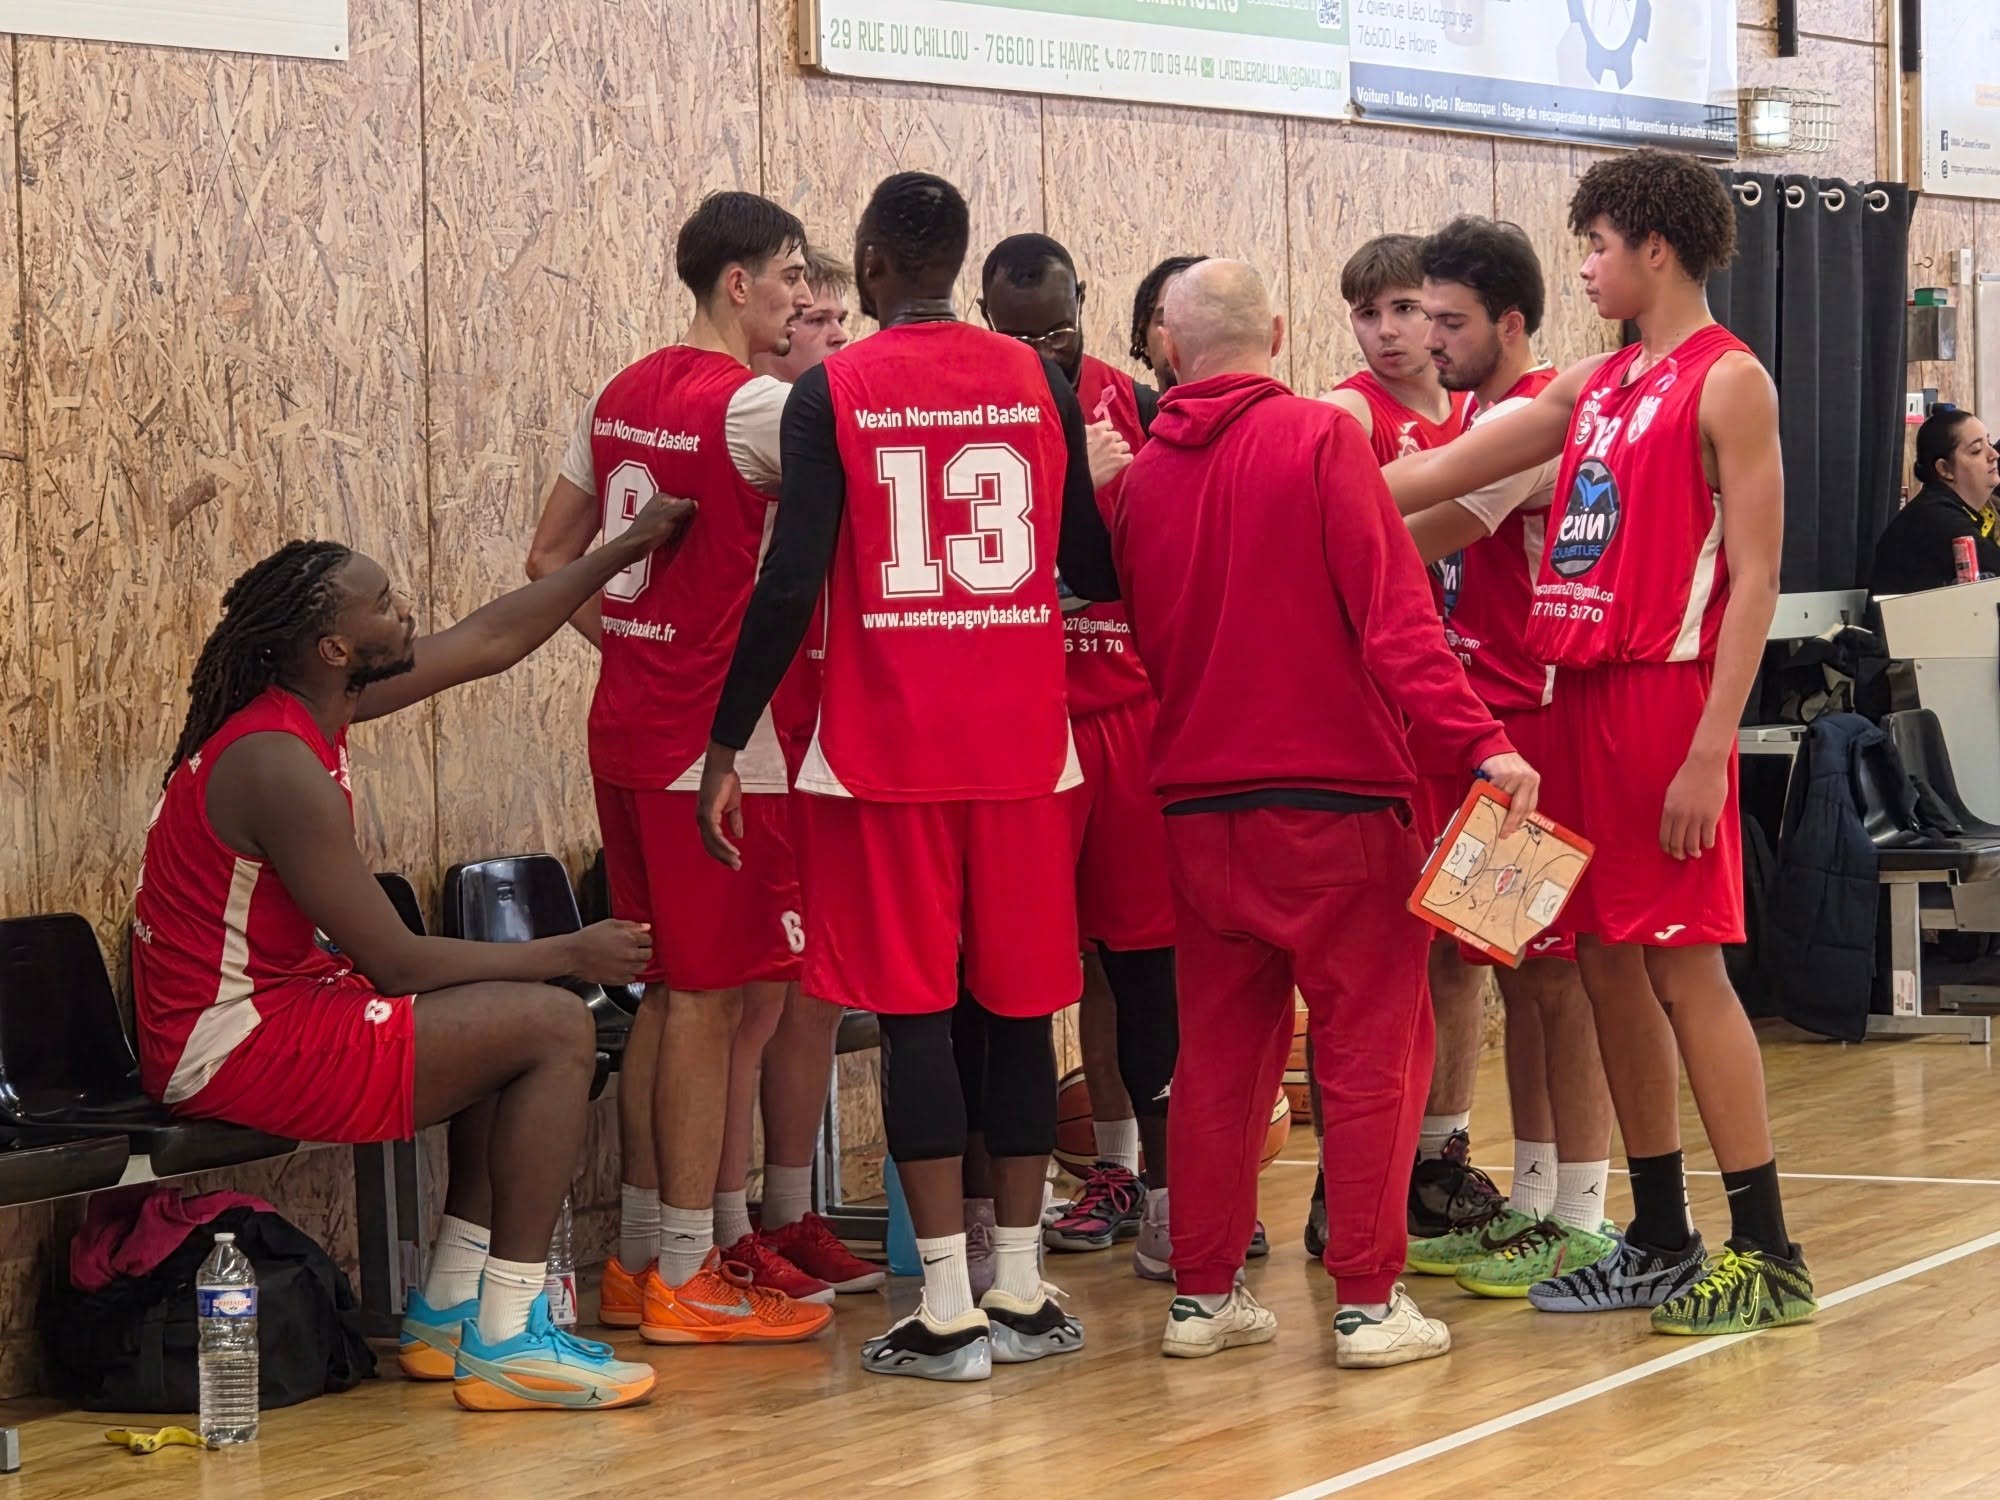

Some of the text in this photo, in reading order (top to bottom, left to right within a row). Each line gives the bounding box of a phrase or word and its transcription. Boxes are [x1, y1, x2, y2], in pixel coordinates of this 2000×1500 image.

[830, 18, 852, 50] 29
[858, 20, 885, 53] RUE
[890, 23, 908, 55] DU
[985, 33, 1034, 67] 76600
[1040, 39, 1055, 69] LE
[1059, 41, 1100, 73] HAVRE
[1116, 48, 1130, 70] 02
[1133, 50, 1147, 72] 77
[1150, 52, 1164, 74] 00
[1167, 53, 1181, 76] 09
[1184, 55, 1198, 77] 44
[1357, 25, 1392, 49] 76600
[1394, 29, 1406, 50] Le
[1356, 86, 1390, 105] Voiture
[1396, 90, 1418, 108] Moto
[1424, 93, 1449, 112] Cyclo
[1454, 97, 1497, 118] Remorque
[1502, 103, 1526, 121] Stage
[1526, 105, 1537, 119] de
[1588, 112, 1598, 127] de
[1599, 114, 1621, 130] points
[1626, 117, 1668, 134] Intervention
[1669, 122, 1679, 135] de
[855, 402, 1041, 429] Vexin Normand Basket
[657, 429, 701, 452] Basket
[876, 443, 1036, 599] 13
[862, 604, 1051, 630] www.usetrepagnybasket.fr
[1582, 605, 1604, 623] 70
[1079, 638, 1098, 652] 31
[1105, 639, 1124, 653] 70
[781, 910, 806, 954] 6
